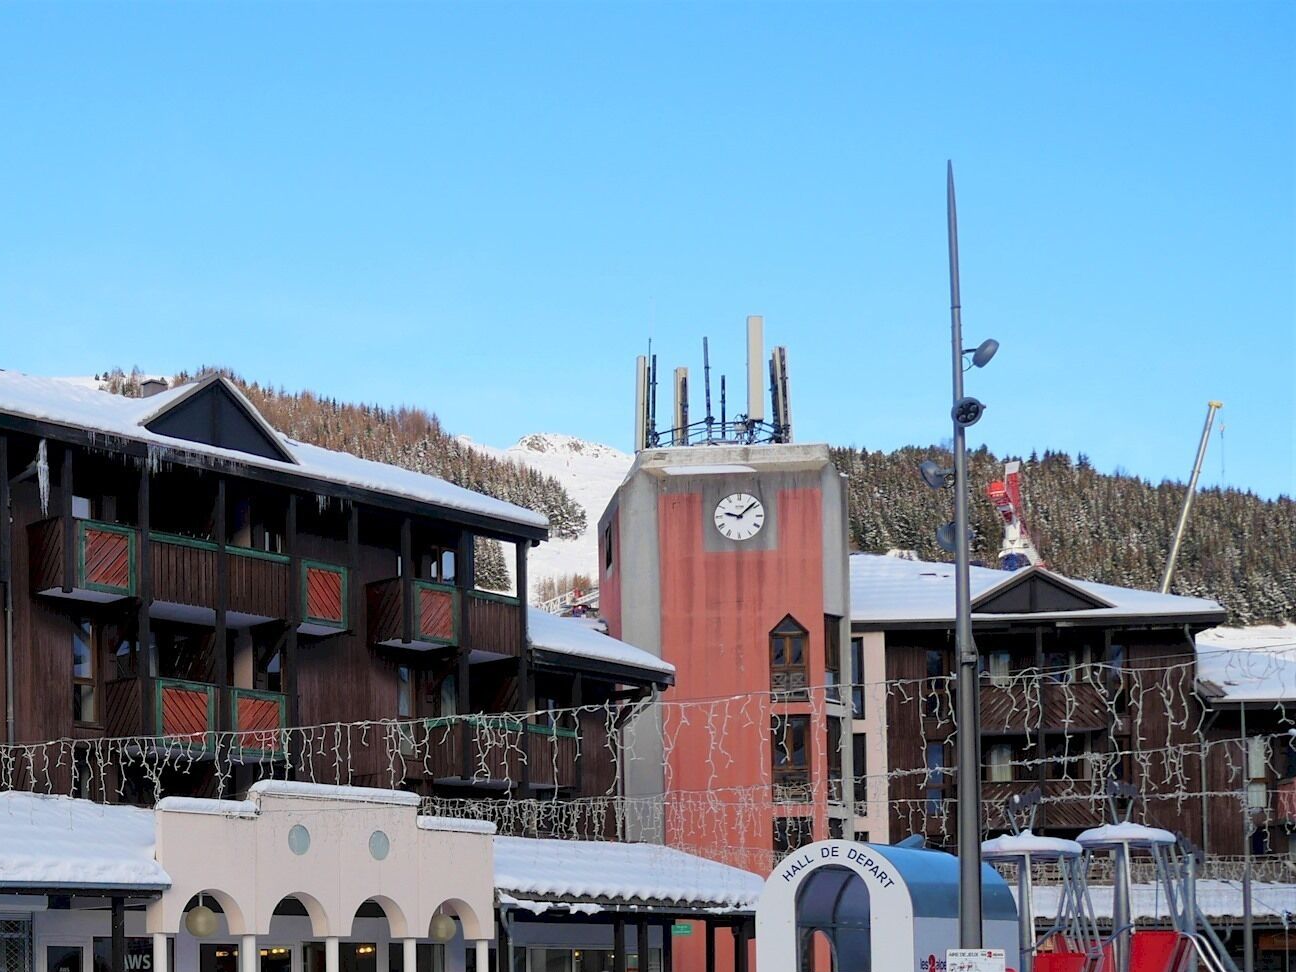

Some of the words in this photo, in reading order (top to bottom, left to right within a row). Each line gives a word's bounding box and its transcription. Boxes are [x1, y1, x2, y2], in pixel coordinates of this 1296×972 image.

[781, 855, 815, 882] HALL
[821, 846, 840, 858] DE
[847, 848, 895, 889] DEPART
